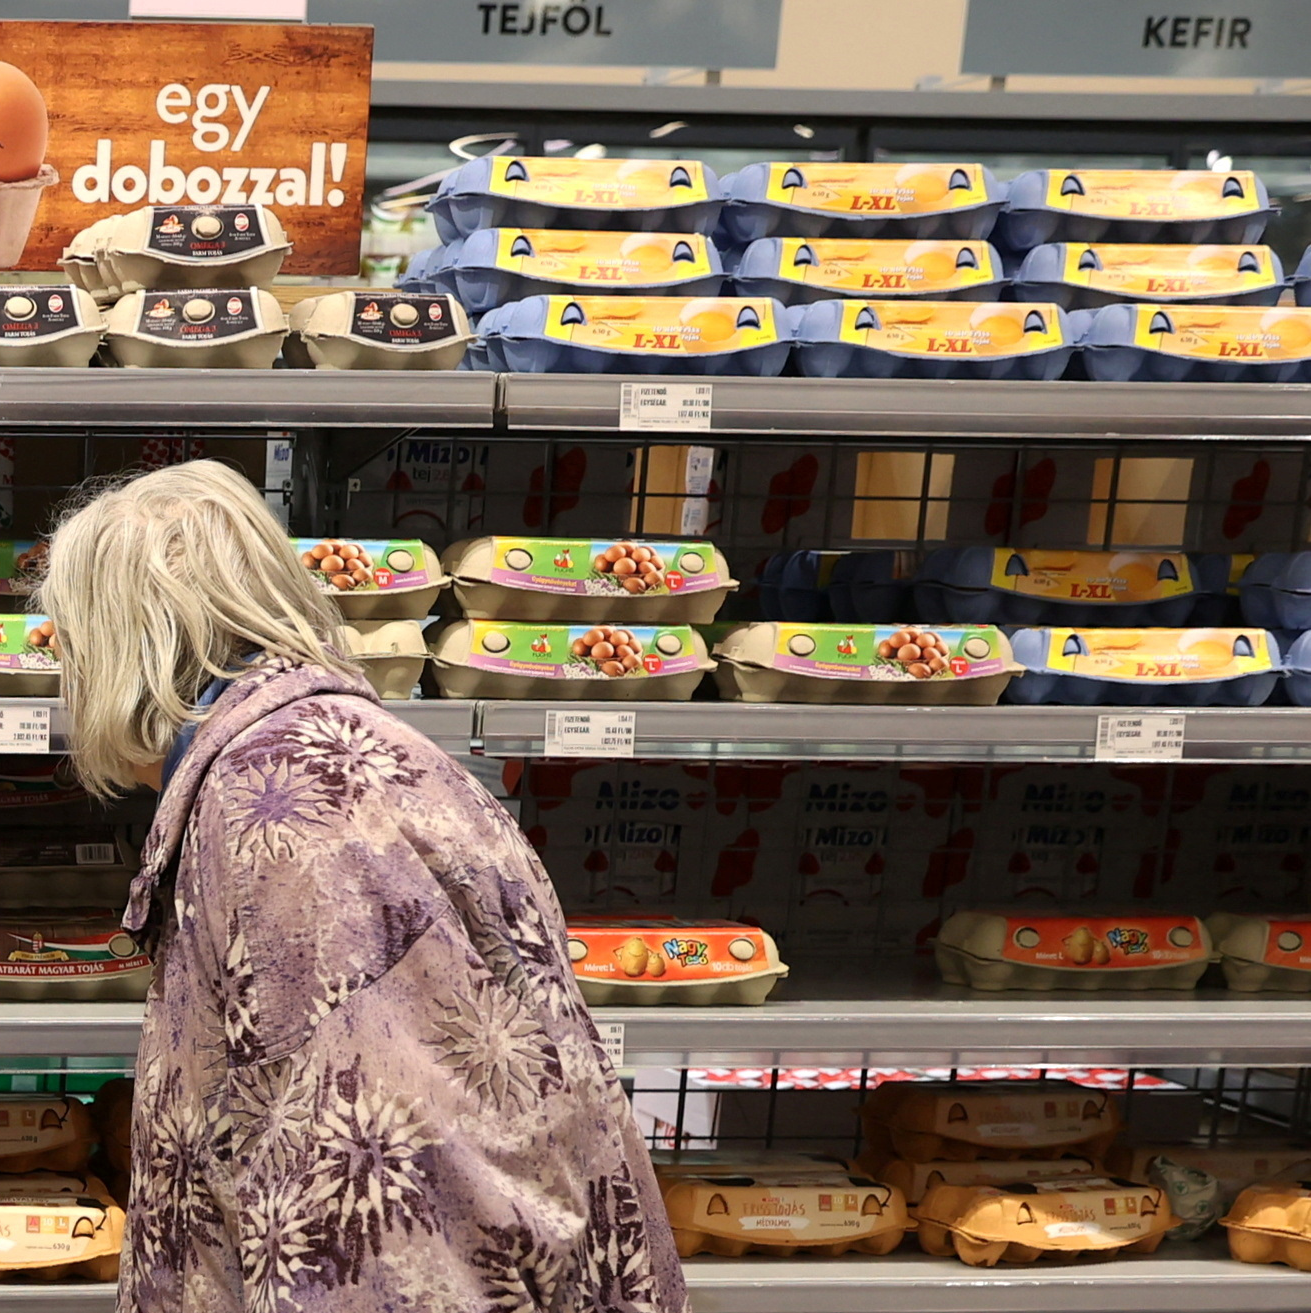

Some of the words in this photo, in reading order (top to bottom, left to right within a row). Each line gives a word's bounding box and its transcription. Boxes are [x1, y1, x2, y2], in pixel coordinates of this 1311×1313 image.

[1142, 16, 1252, 49] KEFIR
[156, 83, 271, 152] egy
[71, 139, 348, 207] dobozzal!
[574, 190, 618, 204] L-XL
[850, 196, 895, 210] L-XL
[1130, 203, 1172, 216] L-XL
[579, 266, 622, 280] L-XL
[862, 274, 905, 288] L-XL
[1146, 279, 1190, 292] L-XL
[633, 334, 680, 349] L-XL
[927, 338, 972, 352] L-XL
[1219, 342, 1262, 356] L-XL
[671, 580, 677, 588] L
[1070, 584, 1111, 598] L-XL
[1136, 663, 1181, 676] L-XL
[663, 938, 708, 960] Nagy
[38, 965, 75, 975] MAGYAR
[77, 963, 104, 974] TOJÁS
